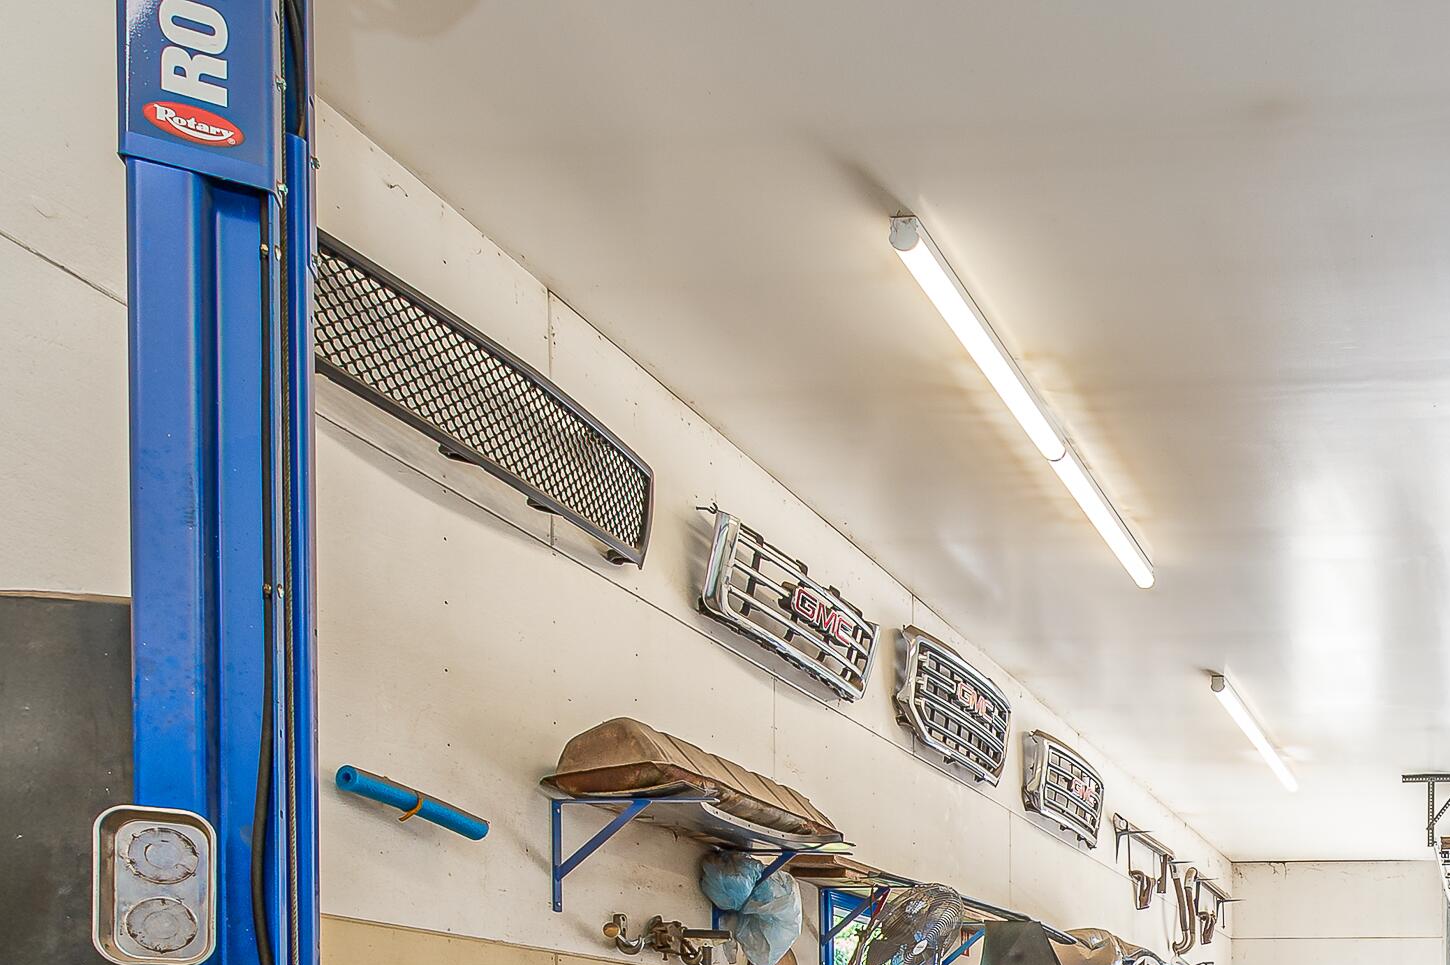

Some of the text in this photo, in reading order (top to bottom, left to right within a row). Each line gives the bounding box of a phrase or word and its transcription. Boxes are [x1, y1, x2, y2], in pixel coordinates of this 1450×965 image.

[154, 104, 235, 138] Rotary
[795, 586, 855, 646] GMC
[958, 682, 993, 722] GMC
